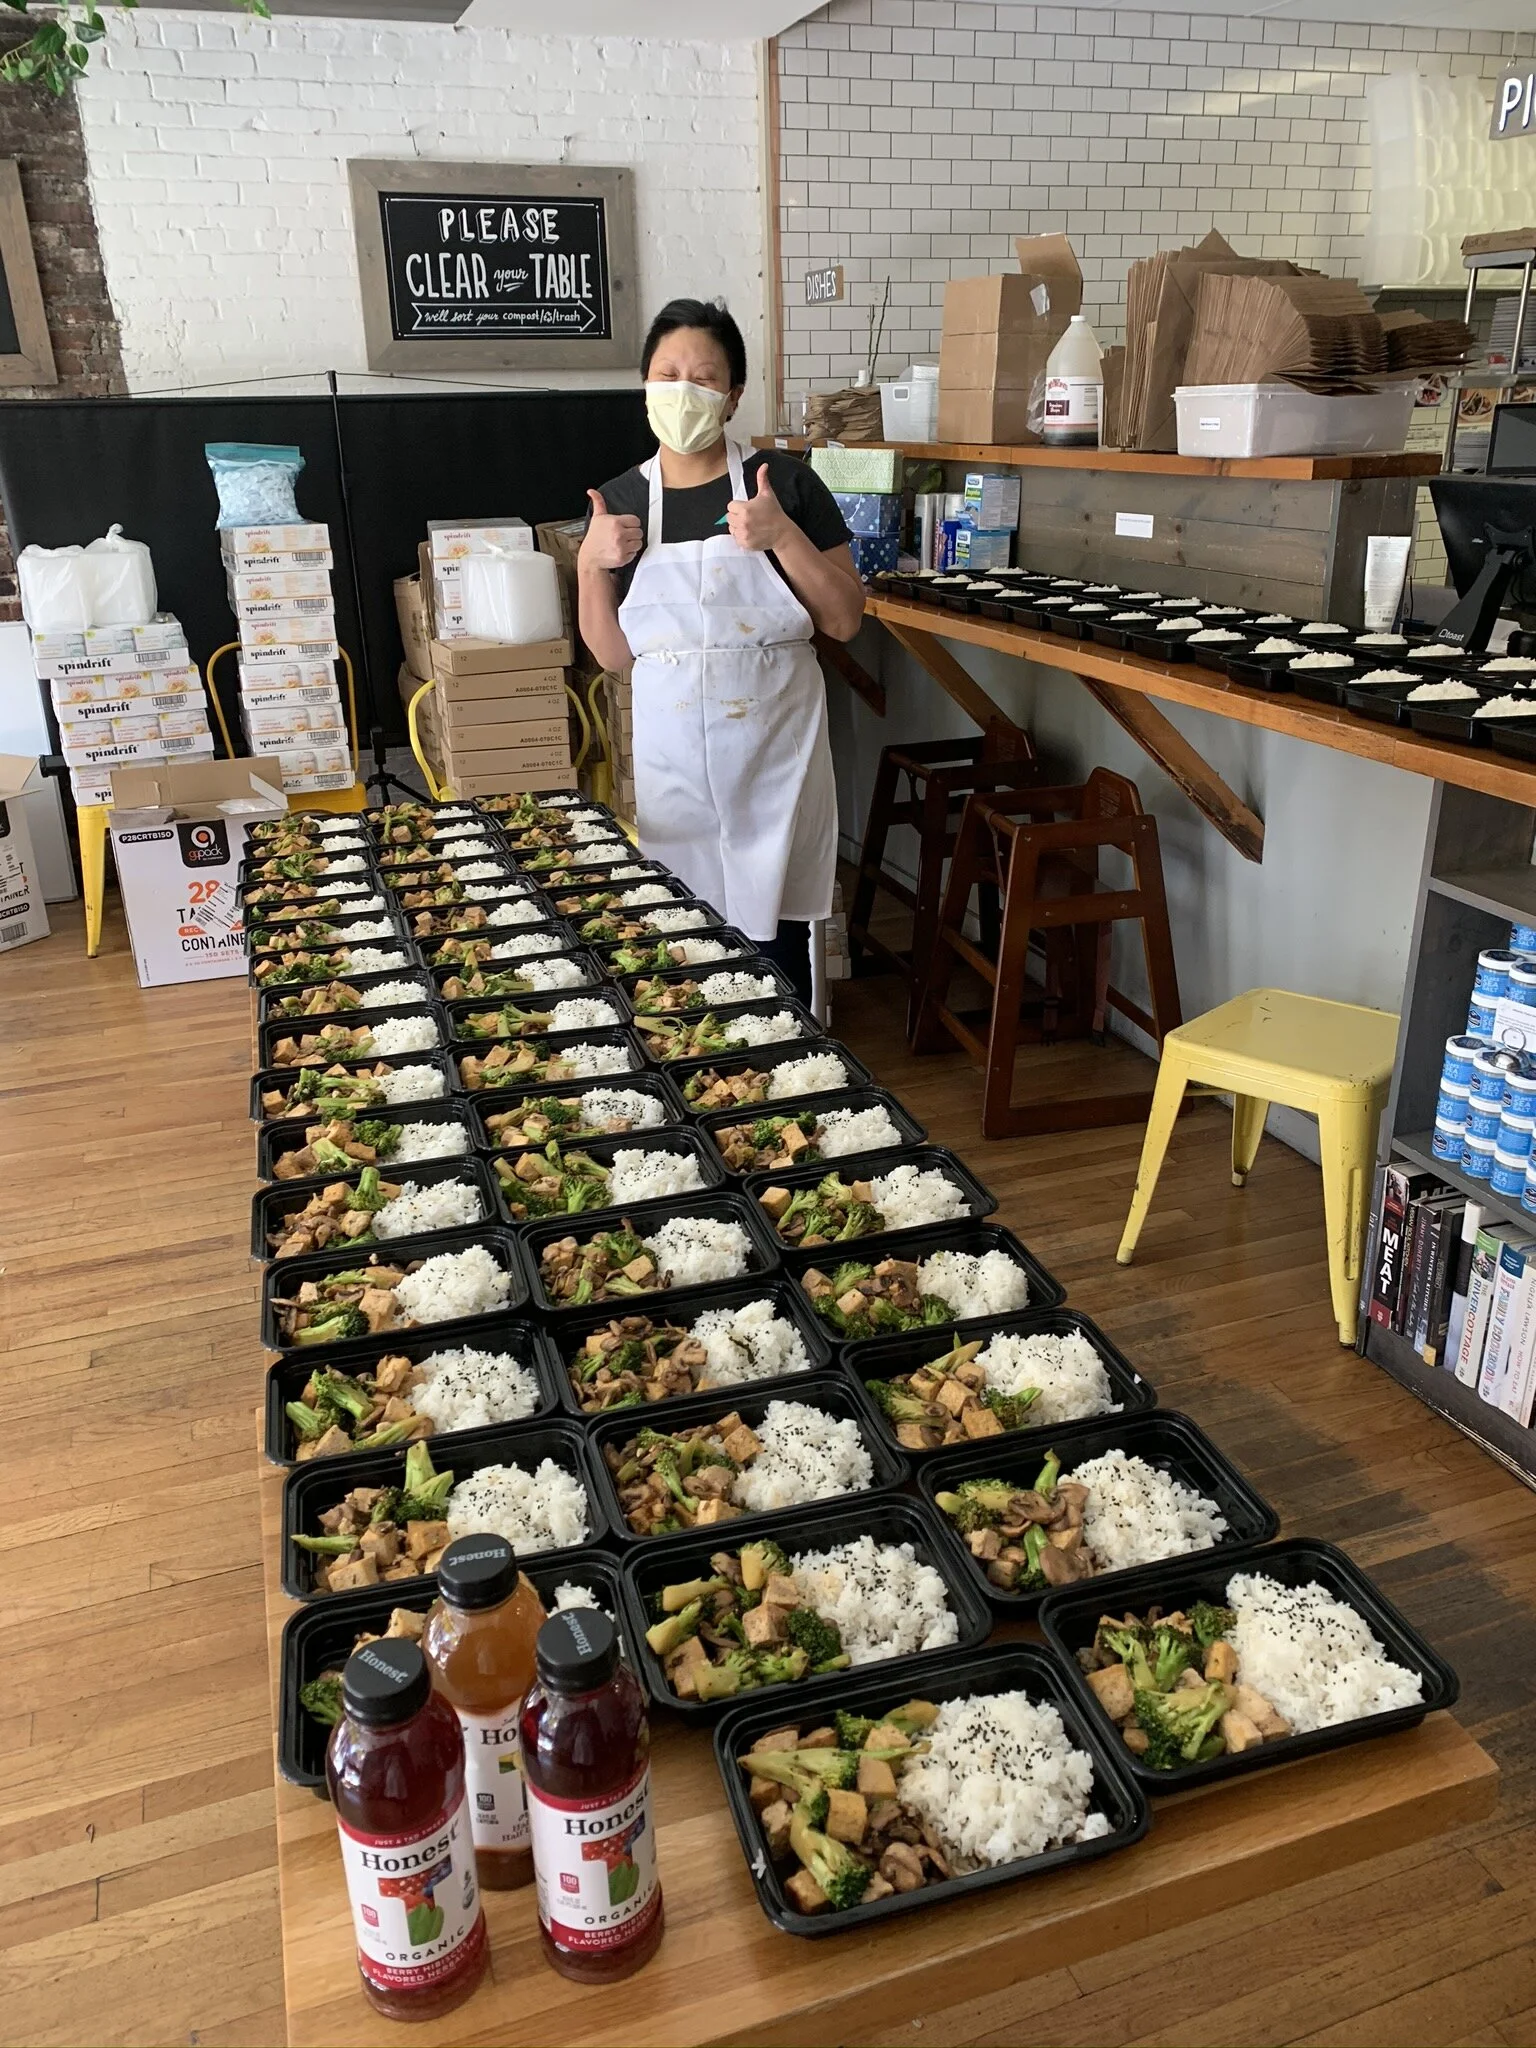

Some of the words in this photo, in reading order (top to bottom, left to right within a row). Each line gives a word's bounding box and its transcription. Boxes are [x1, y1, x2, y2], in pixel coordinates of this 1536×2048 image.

[1499, 73, 1536, 132] PI
[438, 207, 560, 244] PLEASE
[405, 252, 490, 298] CLEAR
[493, 263, 529, 292] your
[529, 253, 593, 299] TABLE
[806, 270, 837, 301] DISHES
[424, 310, 449, 323] we'll
[450, 311, 474, 324] sort
[475, 311, 499, 326] your
[243, 556, 281, 568] spindrift
[245, 603, 282, 615] spindrift
[1446, 630, 1465, 642] toast
[250, 648, 287, 660] spindrift
[58, 657, 112, 675] spindrift
[250, 693, 287, 706] spindrift
[78, 702, 131, 720] spindrift
[86, 744, 138, 762] spindrift
[121, 831, 173, 843] P28CRTB150
[1483, 980, 1499, 988] SEA
[1513, 1099, 1531, 1108] SEA
[1473, 1160, 1490, 1168] SEA
[1379, 1227, 1399, 1295] MEAT
[1423, 1282, 1432, 1311] KITCHEN
[1520, 1311, 1531, 1346] LAWSON
[448, 1547, 507, 1566] Honest
[561, 1612, 593, 1656] Honest
[358, 1649, 408, 1683] Honest
[564, 1775, 649, 1836] Honest
[360, 1818, 460, 1872] Honest
[584, 1879, 653, 1925] ORGANIC
[568, 1933, 622, 1947] FLAVORED
[584, 1928, 618, 1939] BERRY
[385, 1925, 465, 1962] ORGANIC
[372, 1967, 426, 1983] FLAVORED
[386, 1965, 421, 1976] BERRY
